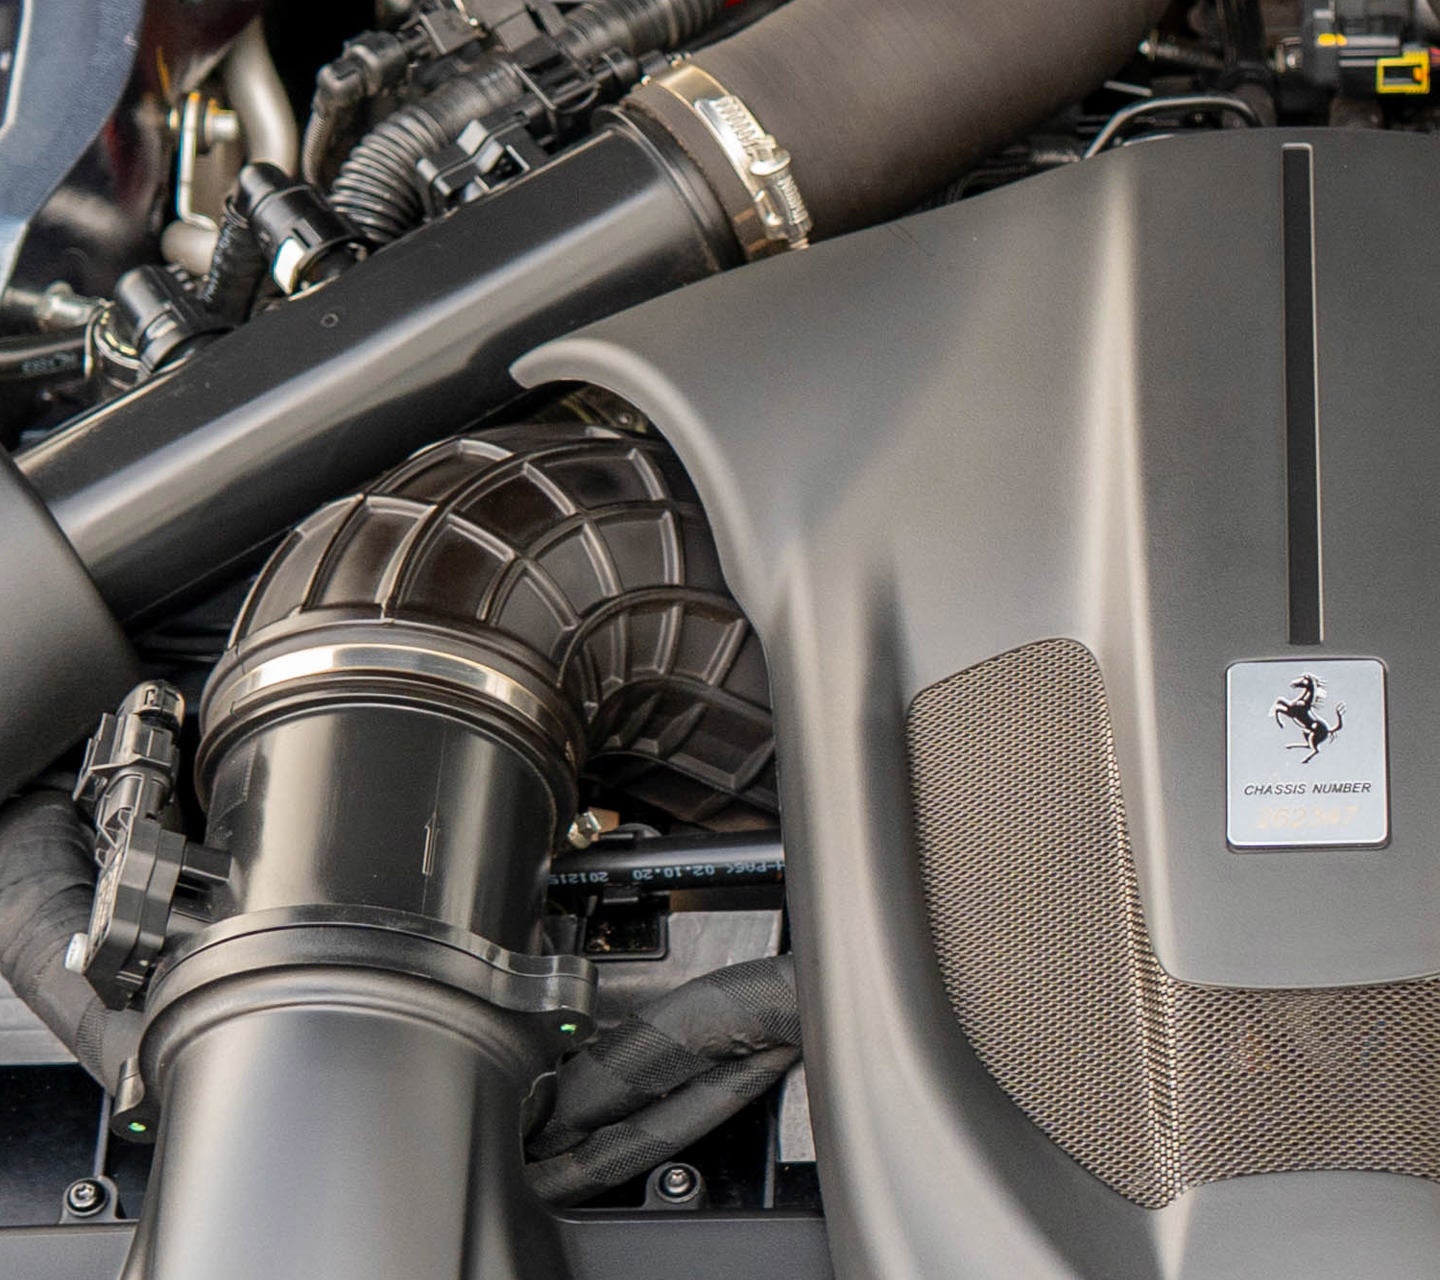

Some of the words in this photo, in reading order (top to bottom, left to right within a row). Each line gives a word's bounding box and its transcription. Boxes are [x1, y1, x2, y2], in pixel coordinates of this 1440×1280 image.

[1244, 783, 1306, 796] CHASSIS
[1312, 782, 1372, 794] NUMBER
[633, 865, 716, 881] 02.10.20
